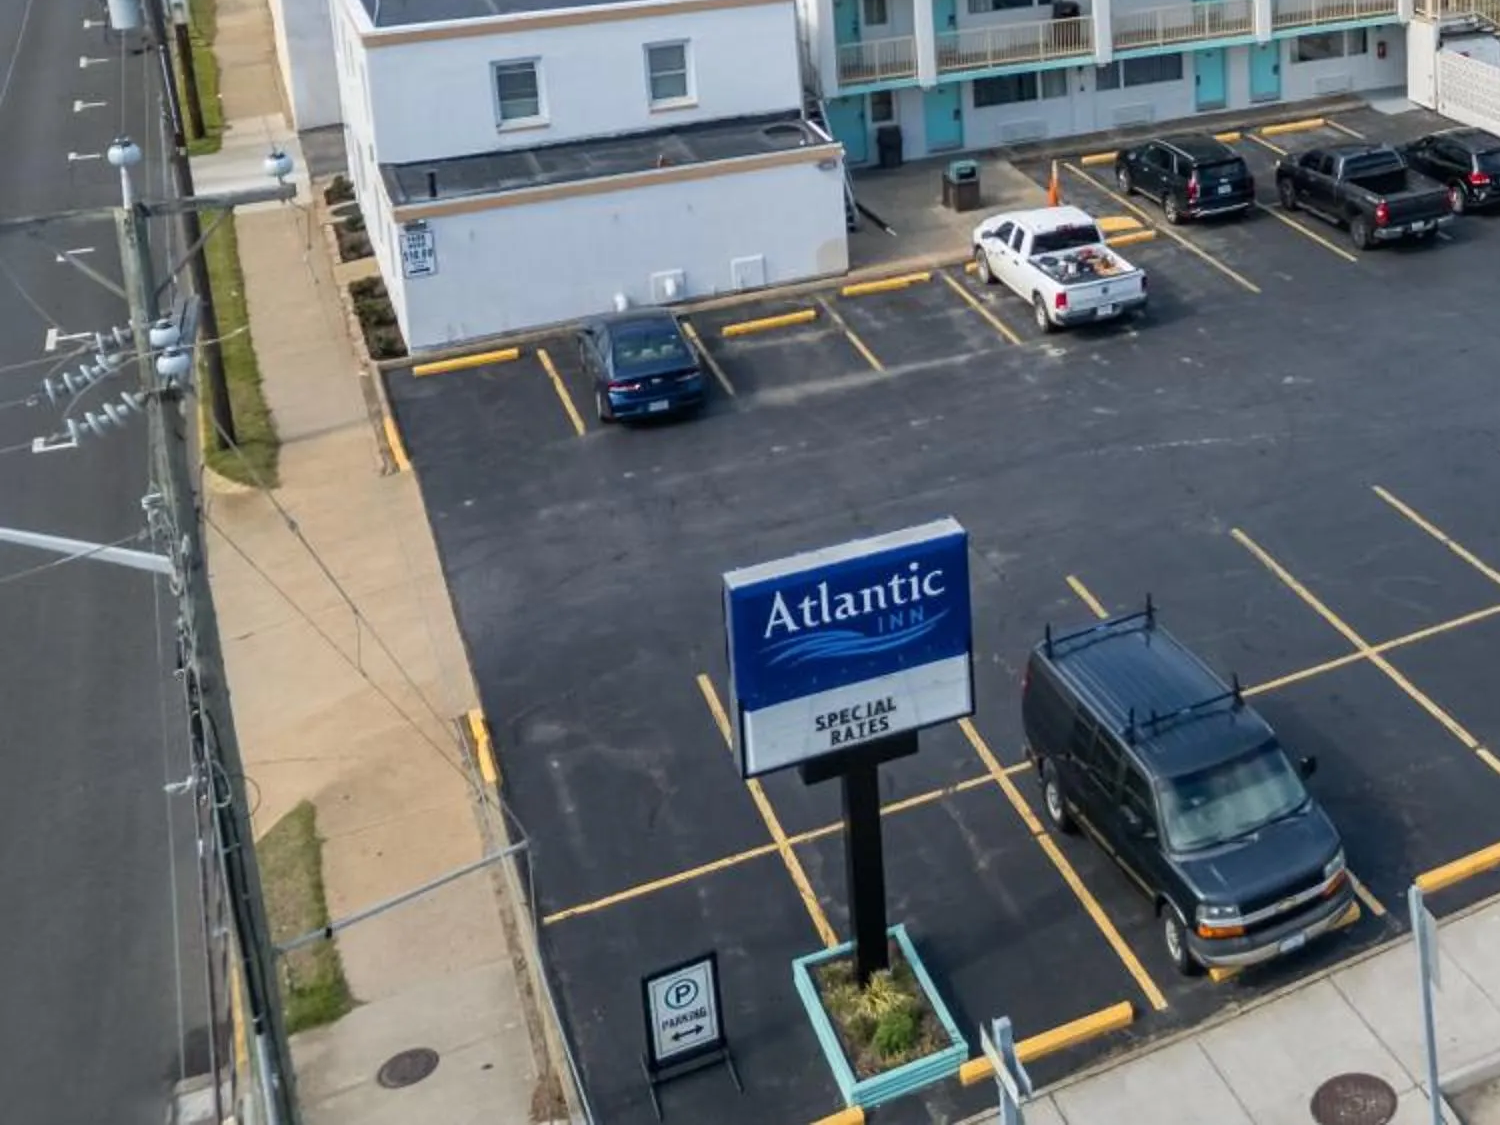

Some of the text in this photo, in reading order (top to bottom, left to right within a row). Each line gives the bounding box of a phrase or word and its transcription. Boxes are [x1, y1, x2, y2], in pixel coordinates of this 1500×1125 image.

[763, 562, 945, 639] Atlantic
[877, 606, 924, 634] INN
[815, 696, 897, 732] SPECIAL
[831, 715, 889, 746] RATES
[675, 984, 691, 1004] P
[661, 1006, 707, 1032] PARKING
